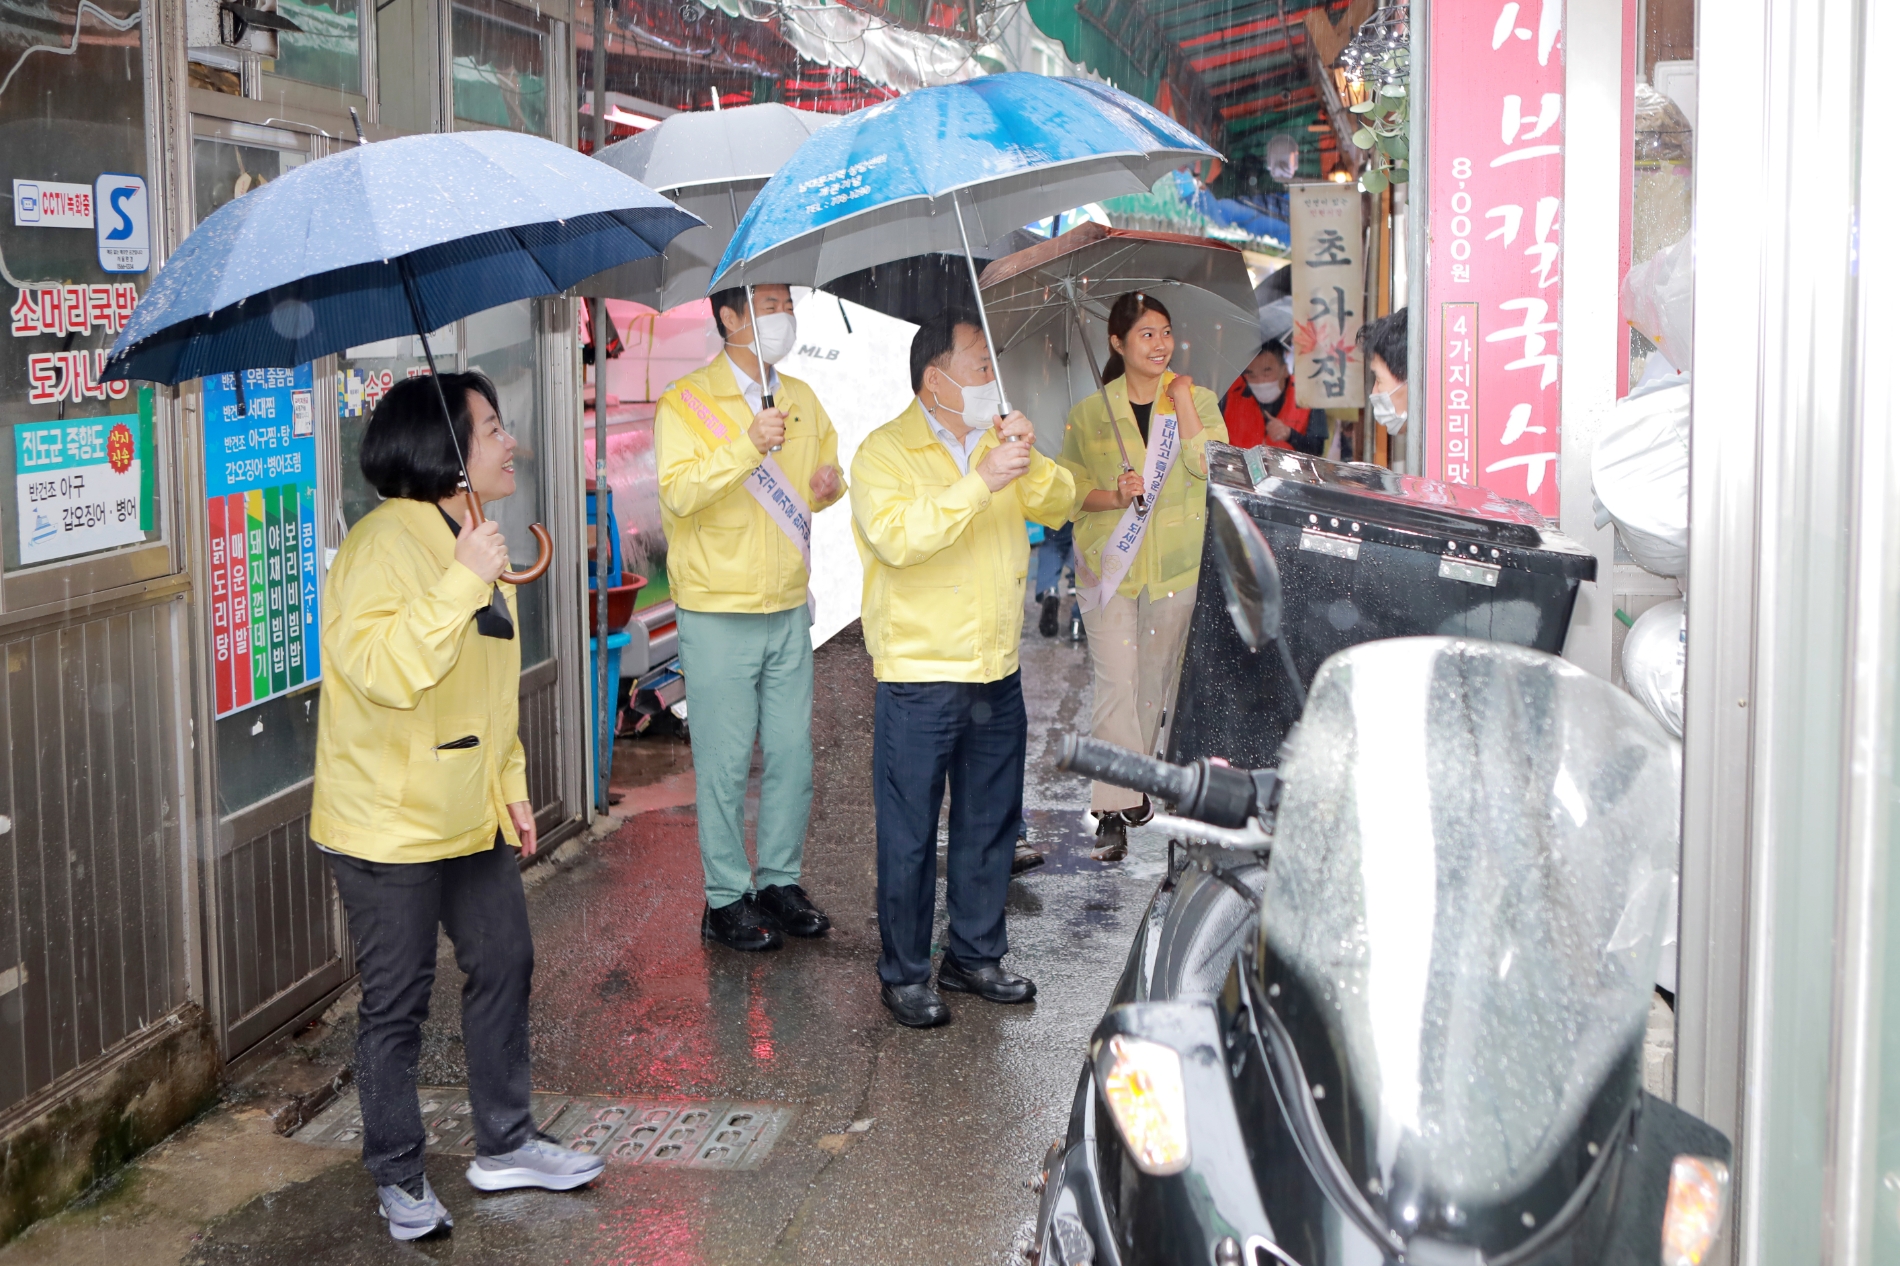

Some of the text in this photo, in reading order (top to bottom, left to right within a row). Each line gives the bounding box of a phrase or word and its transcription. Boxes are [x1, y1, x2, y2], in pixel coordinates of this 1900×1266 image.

[41, 191, 90, 217] CCTV녹화중
[1450, 157, 1472, 283] 8,000원
[12, 285, 137, 334] 소머리국밥
[1305, 229, 1354, 399] 초가집
[798, 345, 840, 361] MLB
[248, 397, 276, 419] 서대찜
[22, 428, 63, 467] 진도군
[111, 431, 129, 448] 산지
[112, 449, 130, 467] 직송
[224, 435, 246, 453] 반건조
[1158, 418, 1177, 460] 힘내시고
[29, 475, 85, 502] 반건조 아구
[1150, 460, 1167, 492] 즐거운
[1117, 523, 1141, 553] 되세요
[302, 522, 315, 606] 콩국수
[212, 536, 229, 661] 닭도리탕
[249, 528, 267, 678] 돼지껍데기
[268, 525, 285, 673] 야채비빔밥
[285, 521, 301, 668] 보리비빔밥
